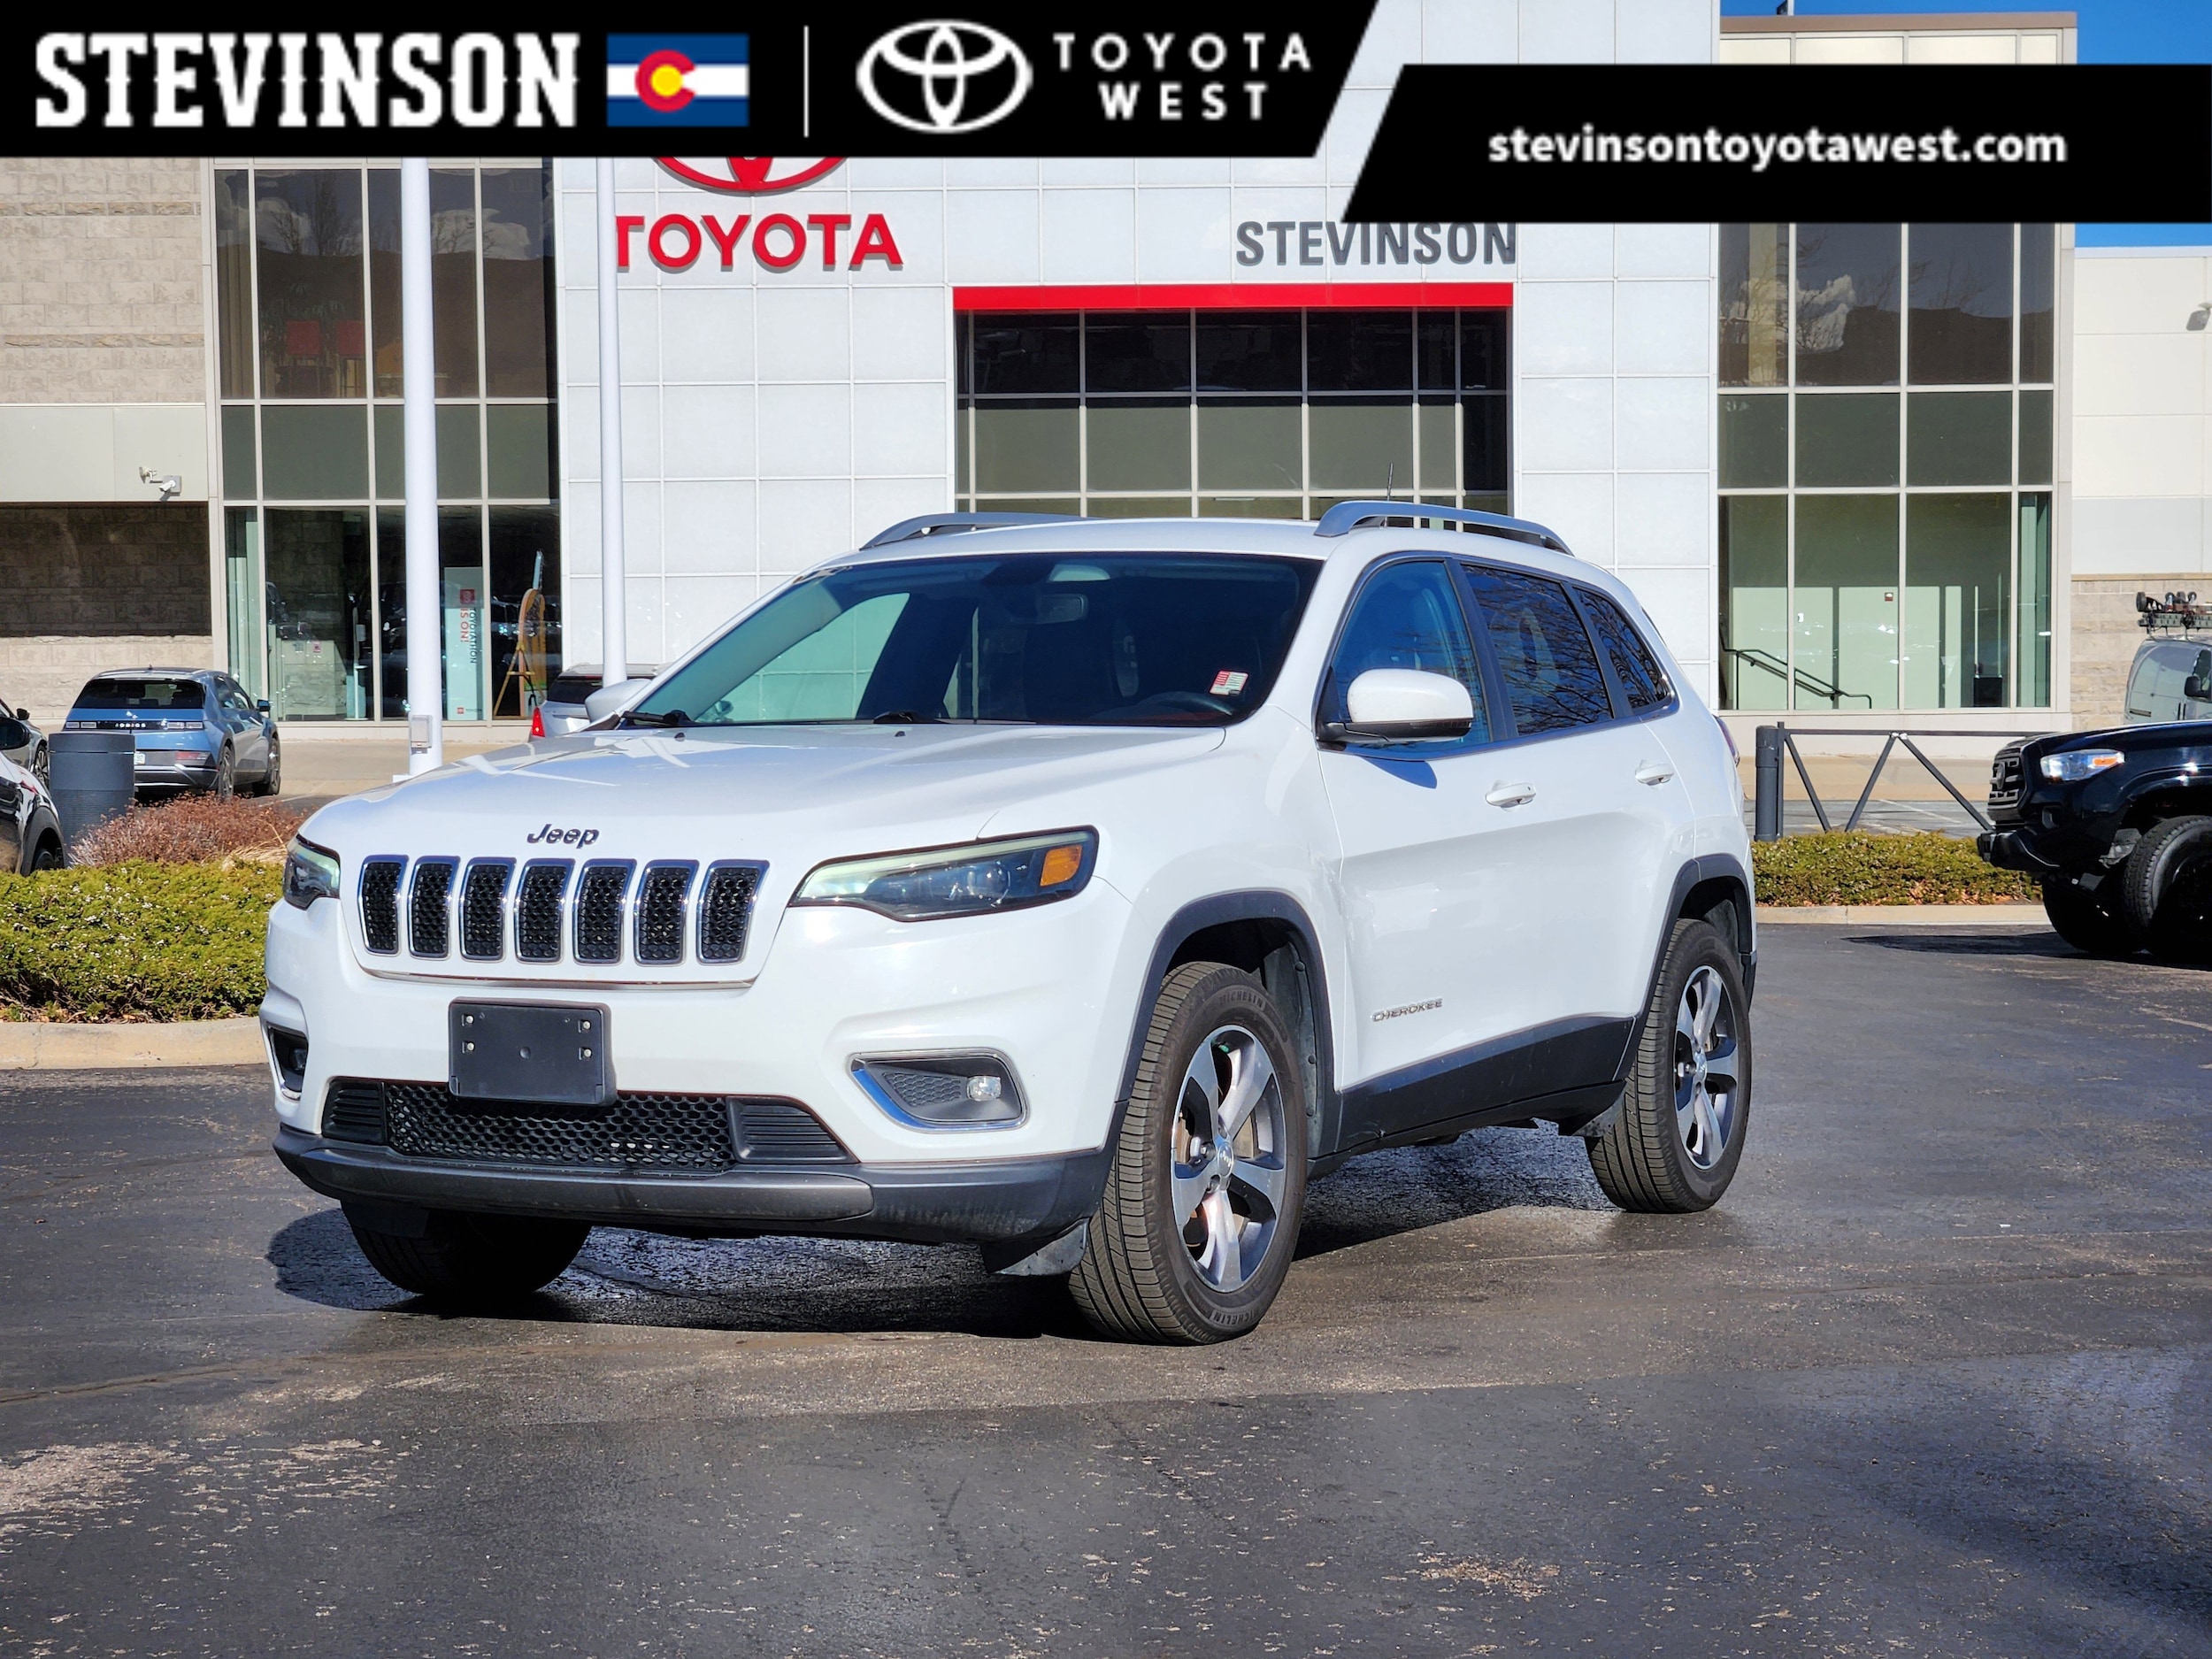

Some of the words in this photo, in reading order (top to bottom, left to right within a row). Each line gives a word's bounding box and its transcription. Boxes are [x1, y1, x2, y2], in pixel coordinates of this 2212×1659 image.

[616, 213, 904, 270] TOYOTA
[1235, 220, 1517, 265] STEVINSON
[526, 824, 600, 849] Jeep
[1371, 997, 1444, 1022] CHEROKEE
